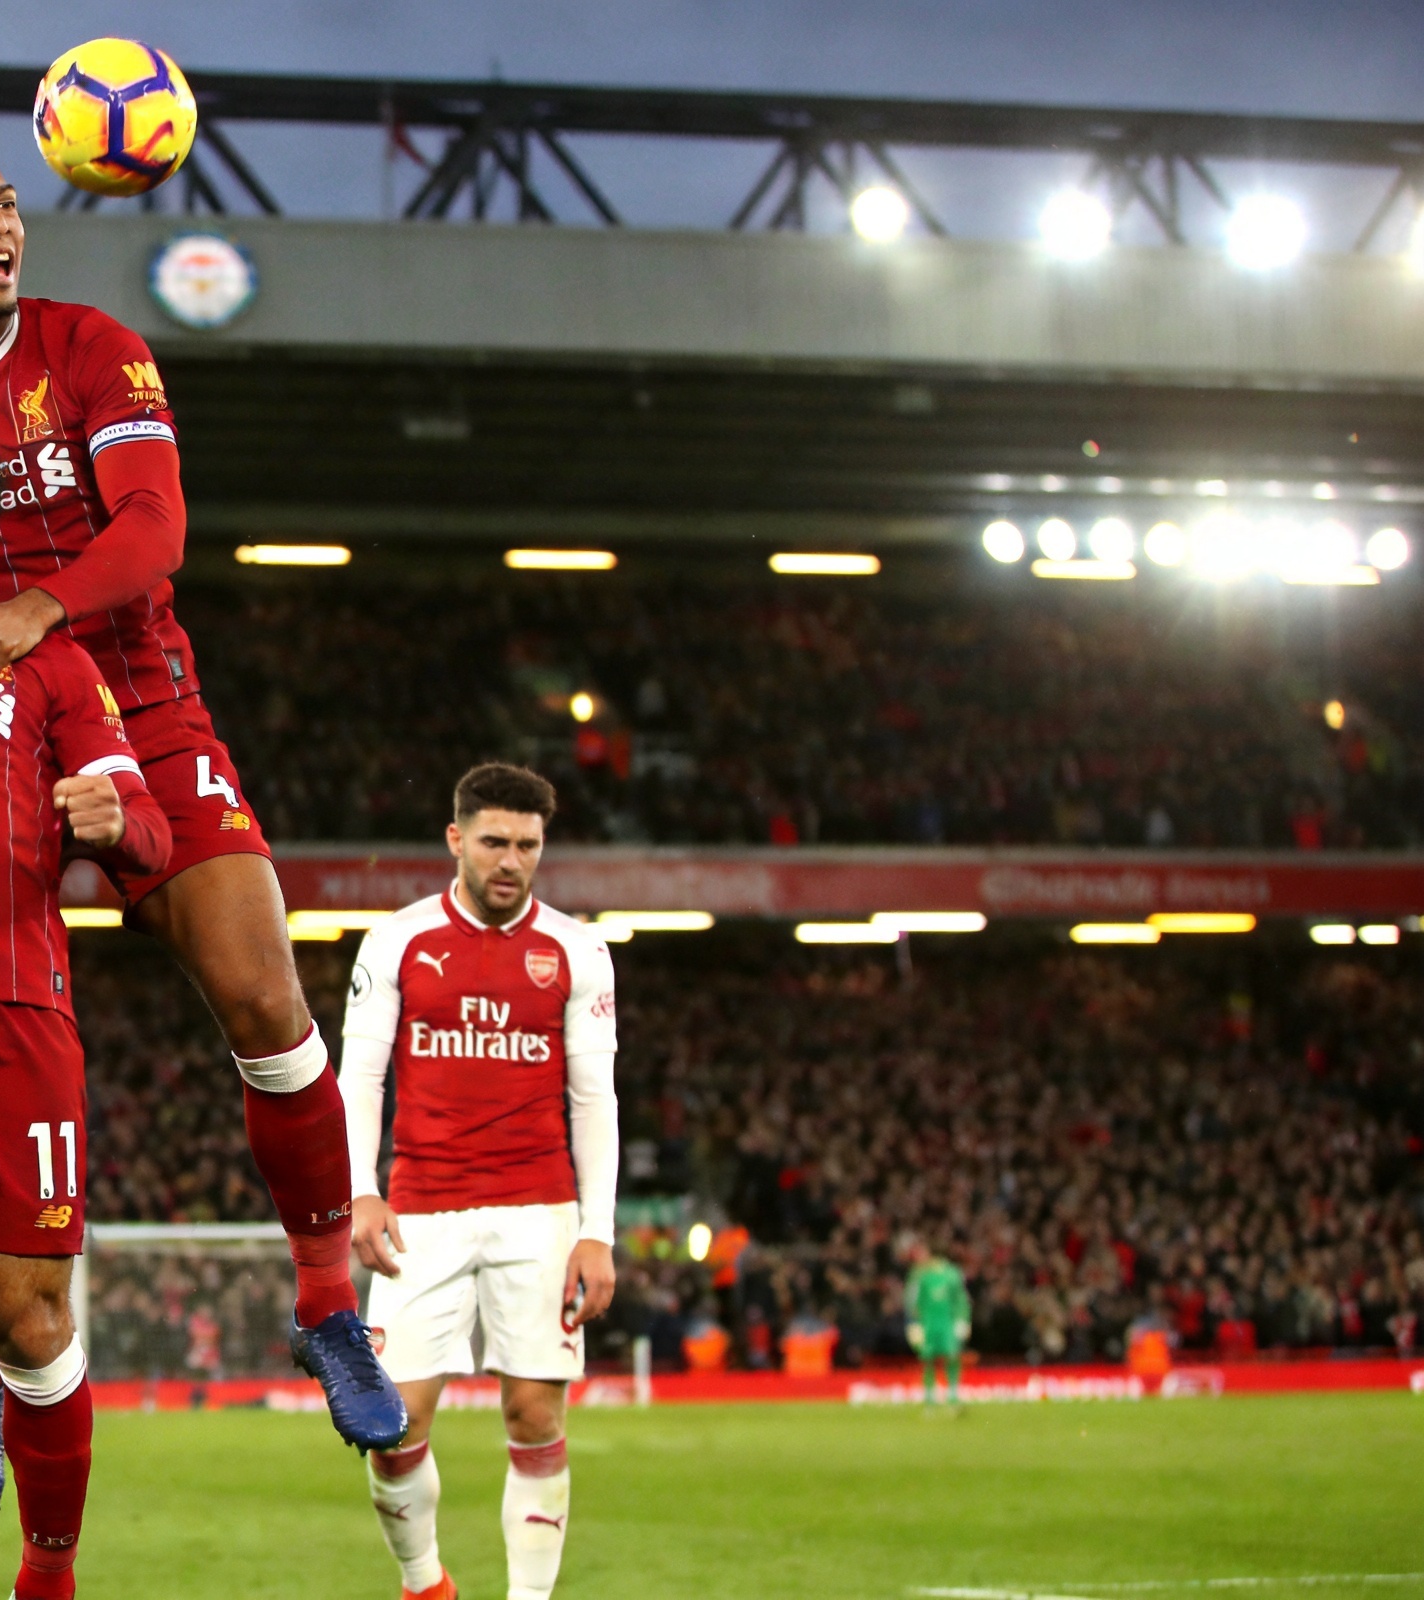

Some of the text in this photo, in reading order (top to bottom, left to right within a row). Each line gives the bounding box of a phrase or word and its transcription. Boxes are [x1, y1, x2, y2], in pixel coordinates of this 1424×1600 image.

[196, 756, 240, 808] 4
[460, 996, 511, 1029] Fly
[410, 1022, 551, 1062] Emirates
[27, 1121, 77, 1199] 11
